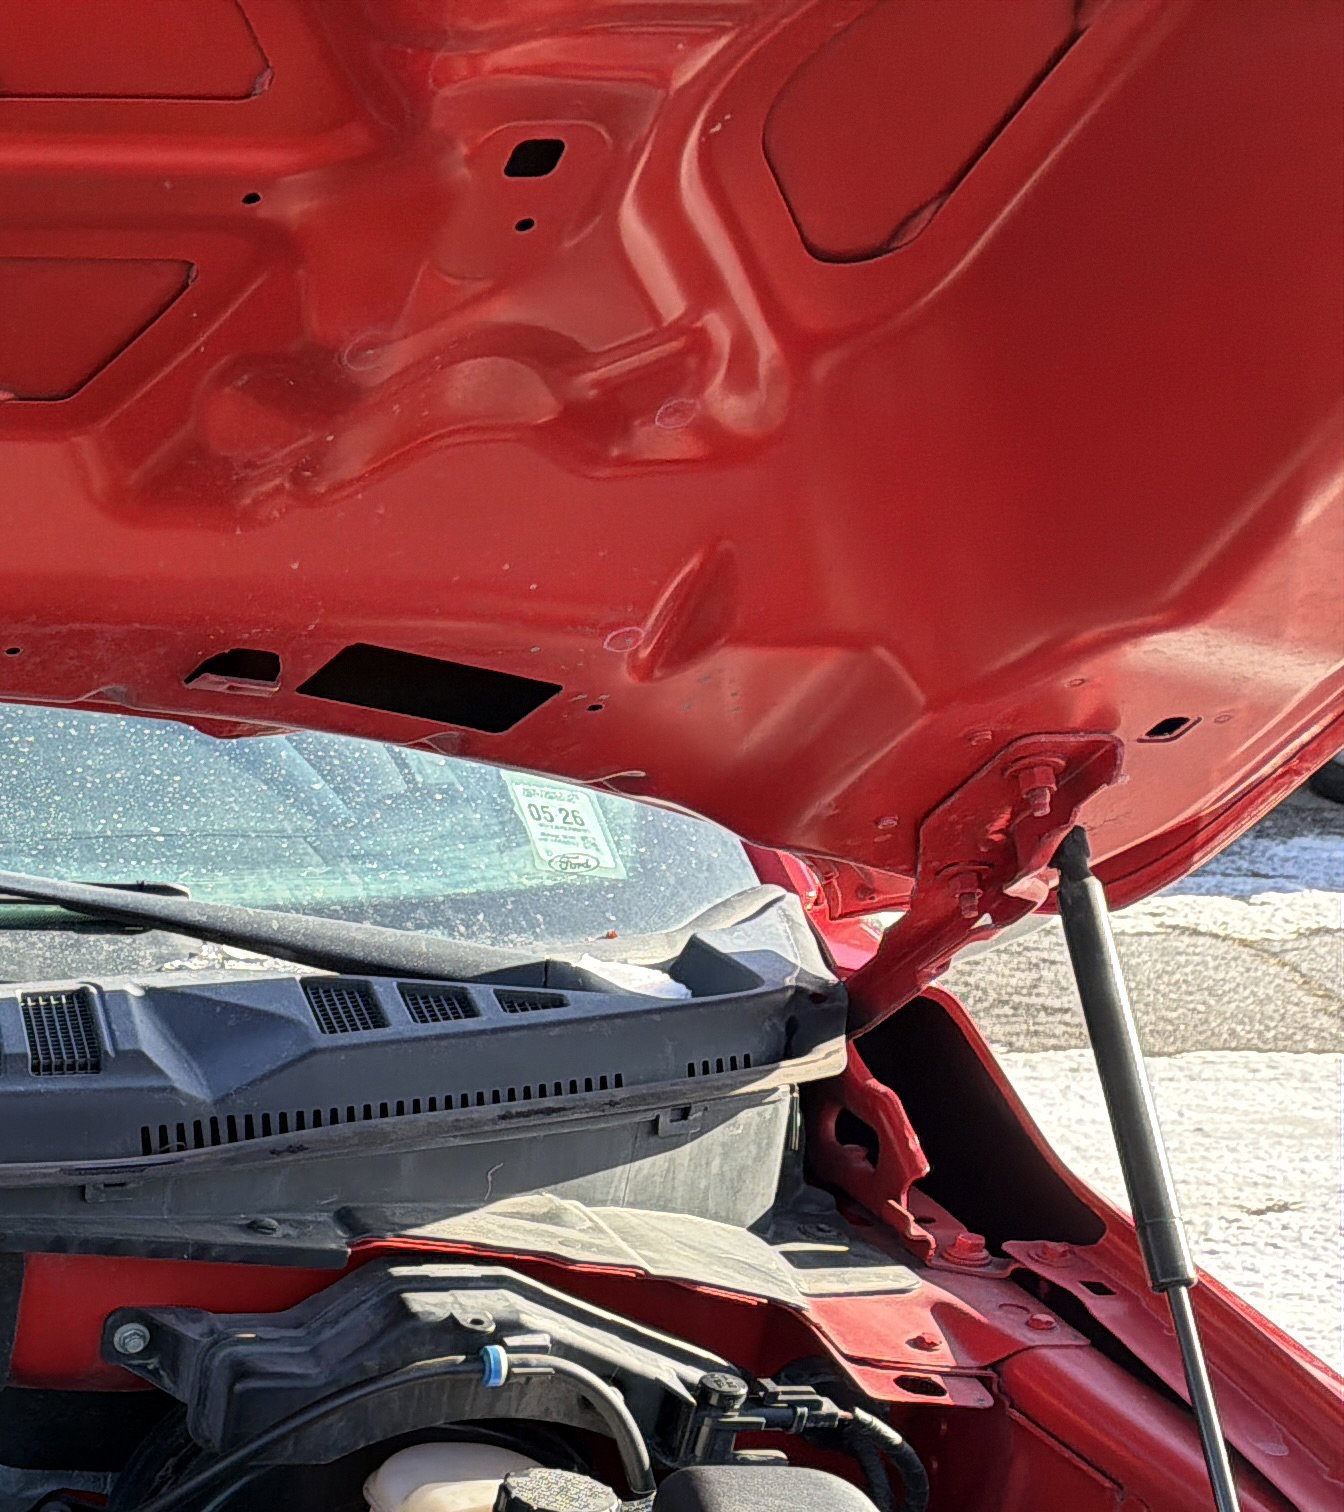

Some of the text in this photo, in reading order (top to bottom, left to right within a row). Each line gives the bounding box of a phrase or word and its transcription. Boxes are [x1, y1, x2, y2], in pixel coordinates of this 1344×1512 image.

[528, 803, 585, 826] 05 26
[557, 853, 592, 871] Ford
